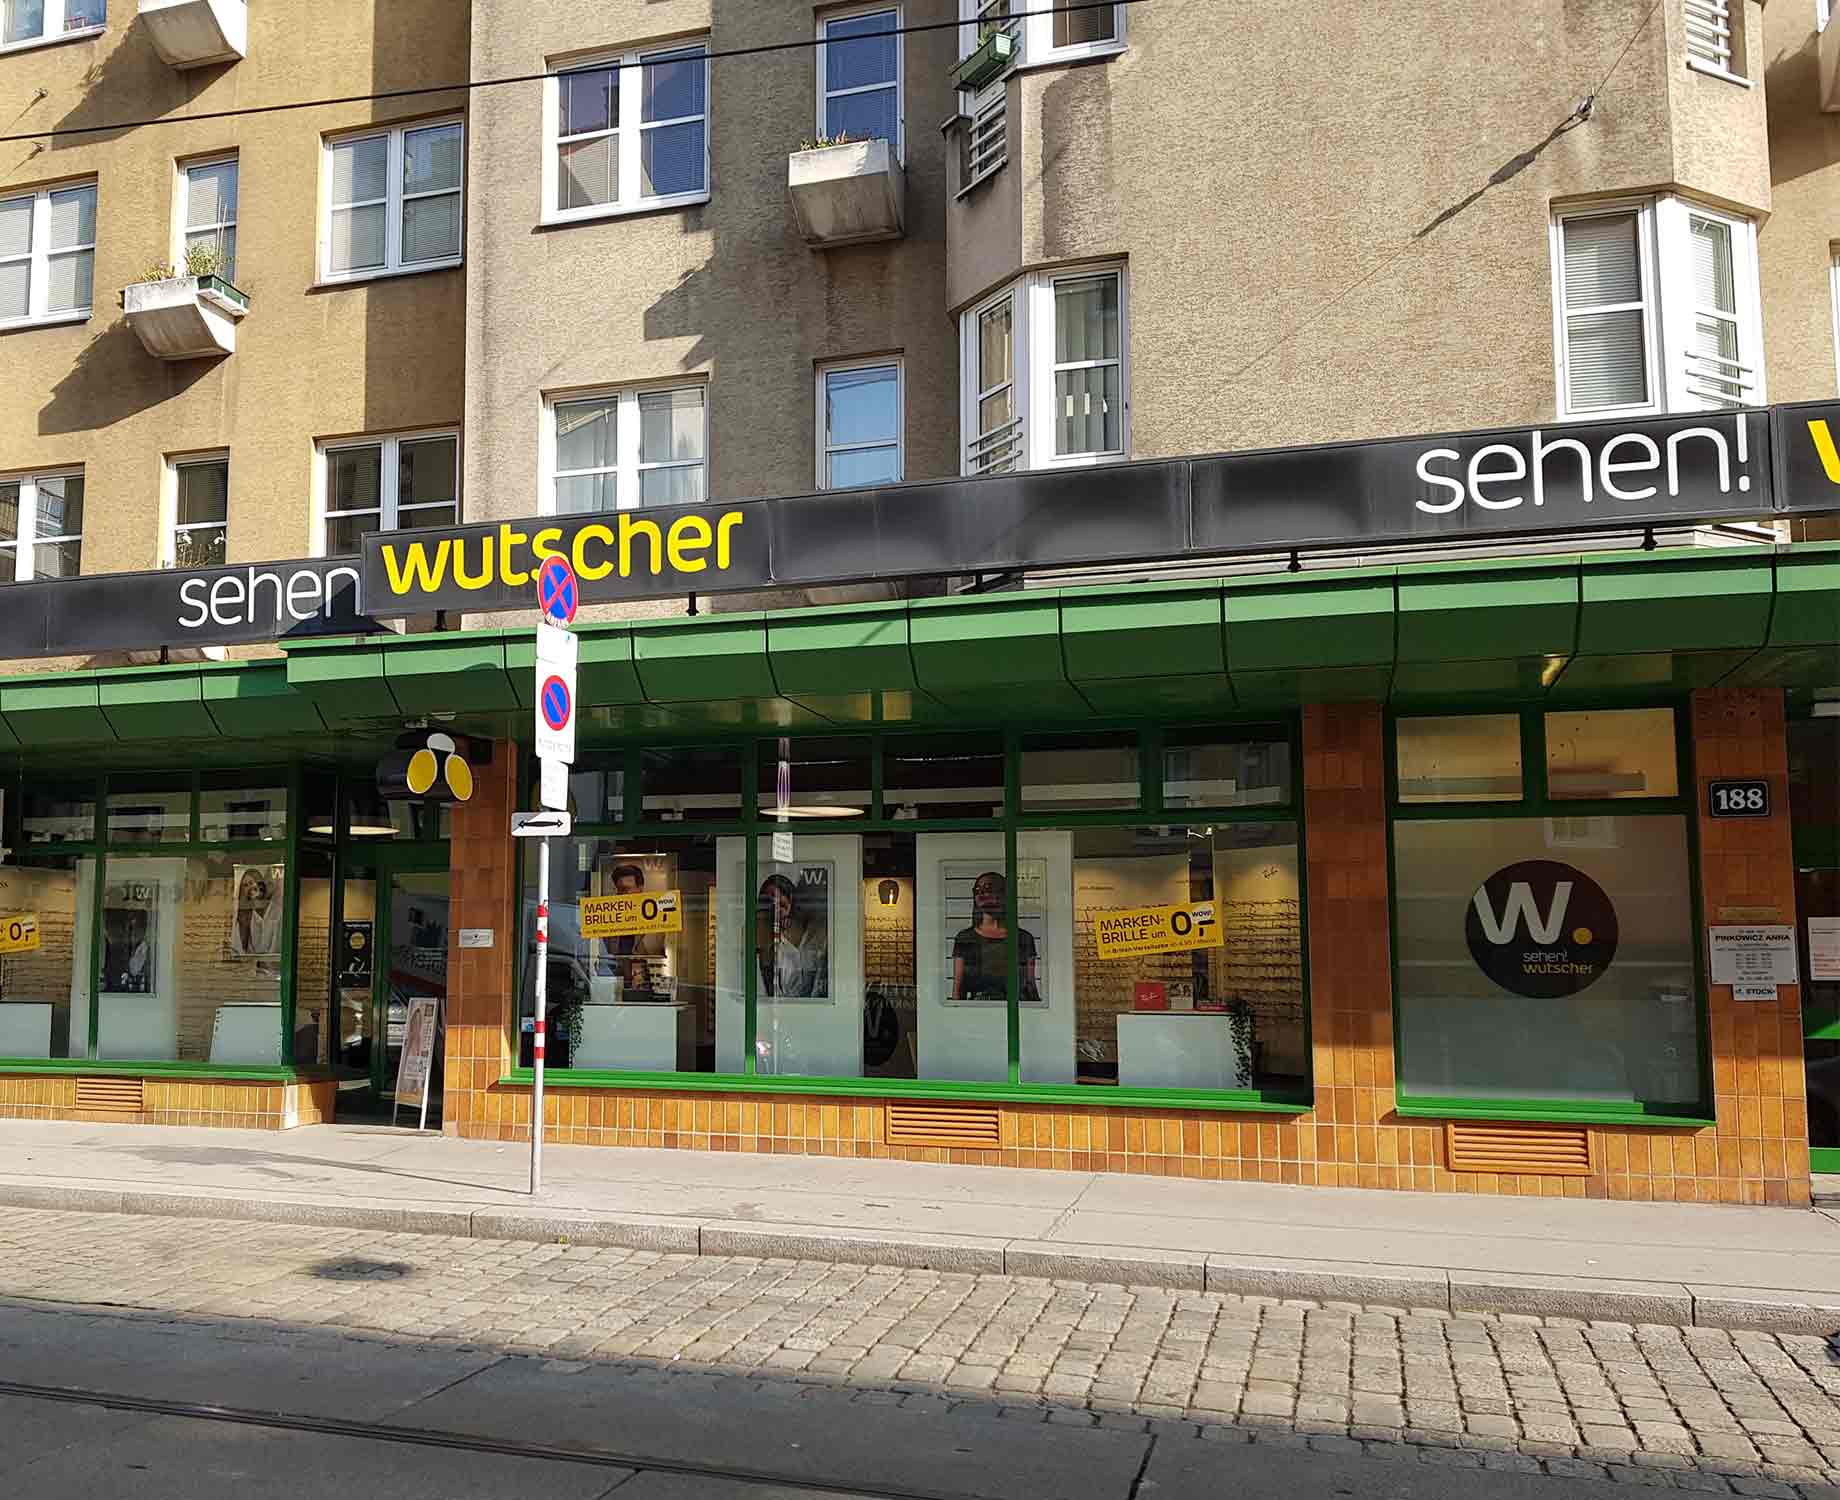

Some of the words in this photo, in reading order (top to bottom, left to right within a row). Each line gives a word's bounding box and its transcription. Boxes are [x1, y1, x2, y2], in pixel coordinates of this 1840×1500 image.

[1415, 413, 1751, 514] sehen!
[381, 511, 744, 596] wutscher
[1715, 787, 1764, 811] 188
[584, 900, 637, 914] MARKEN-
[1472, 880, 1593, 945] W.
[585, 913, 623, 926] BRILLE
[1100, 914, 1165, 932] MARKEN-
[1102, 928, 1149, 944] BRILLE
[1151, 931, 1167, 939] um
[1522, 951, 1568, 963] sehen!
[1522, 963, 1593, 975] wutscher
